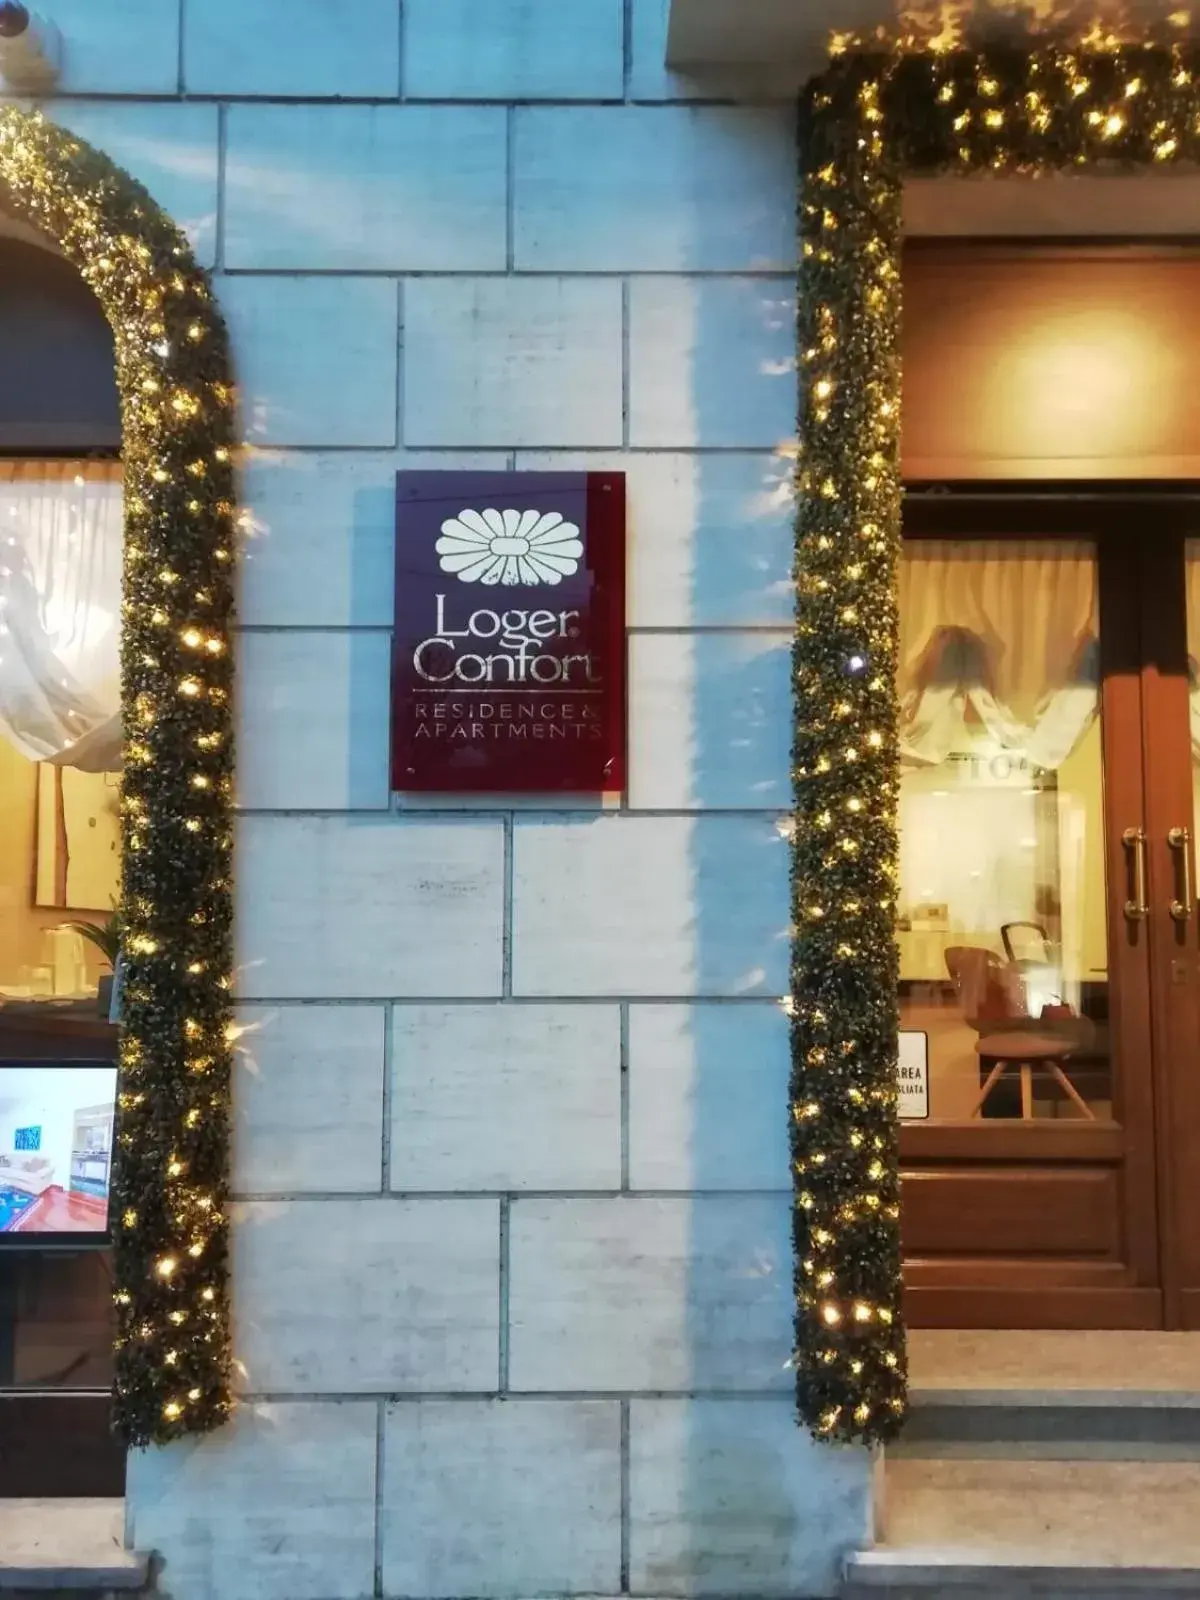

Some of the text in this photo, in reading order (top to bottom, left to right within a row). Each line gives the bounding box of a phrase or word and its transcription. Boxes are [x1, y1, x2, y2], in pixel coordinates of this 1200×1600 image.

[413, 637, 603, 683] Confort
[415, 703, 573, 719] RESIDENCE
[415, 722, 602, 739] APARTMENTS
